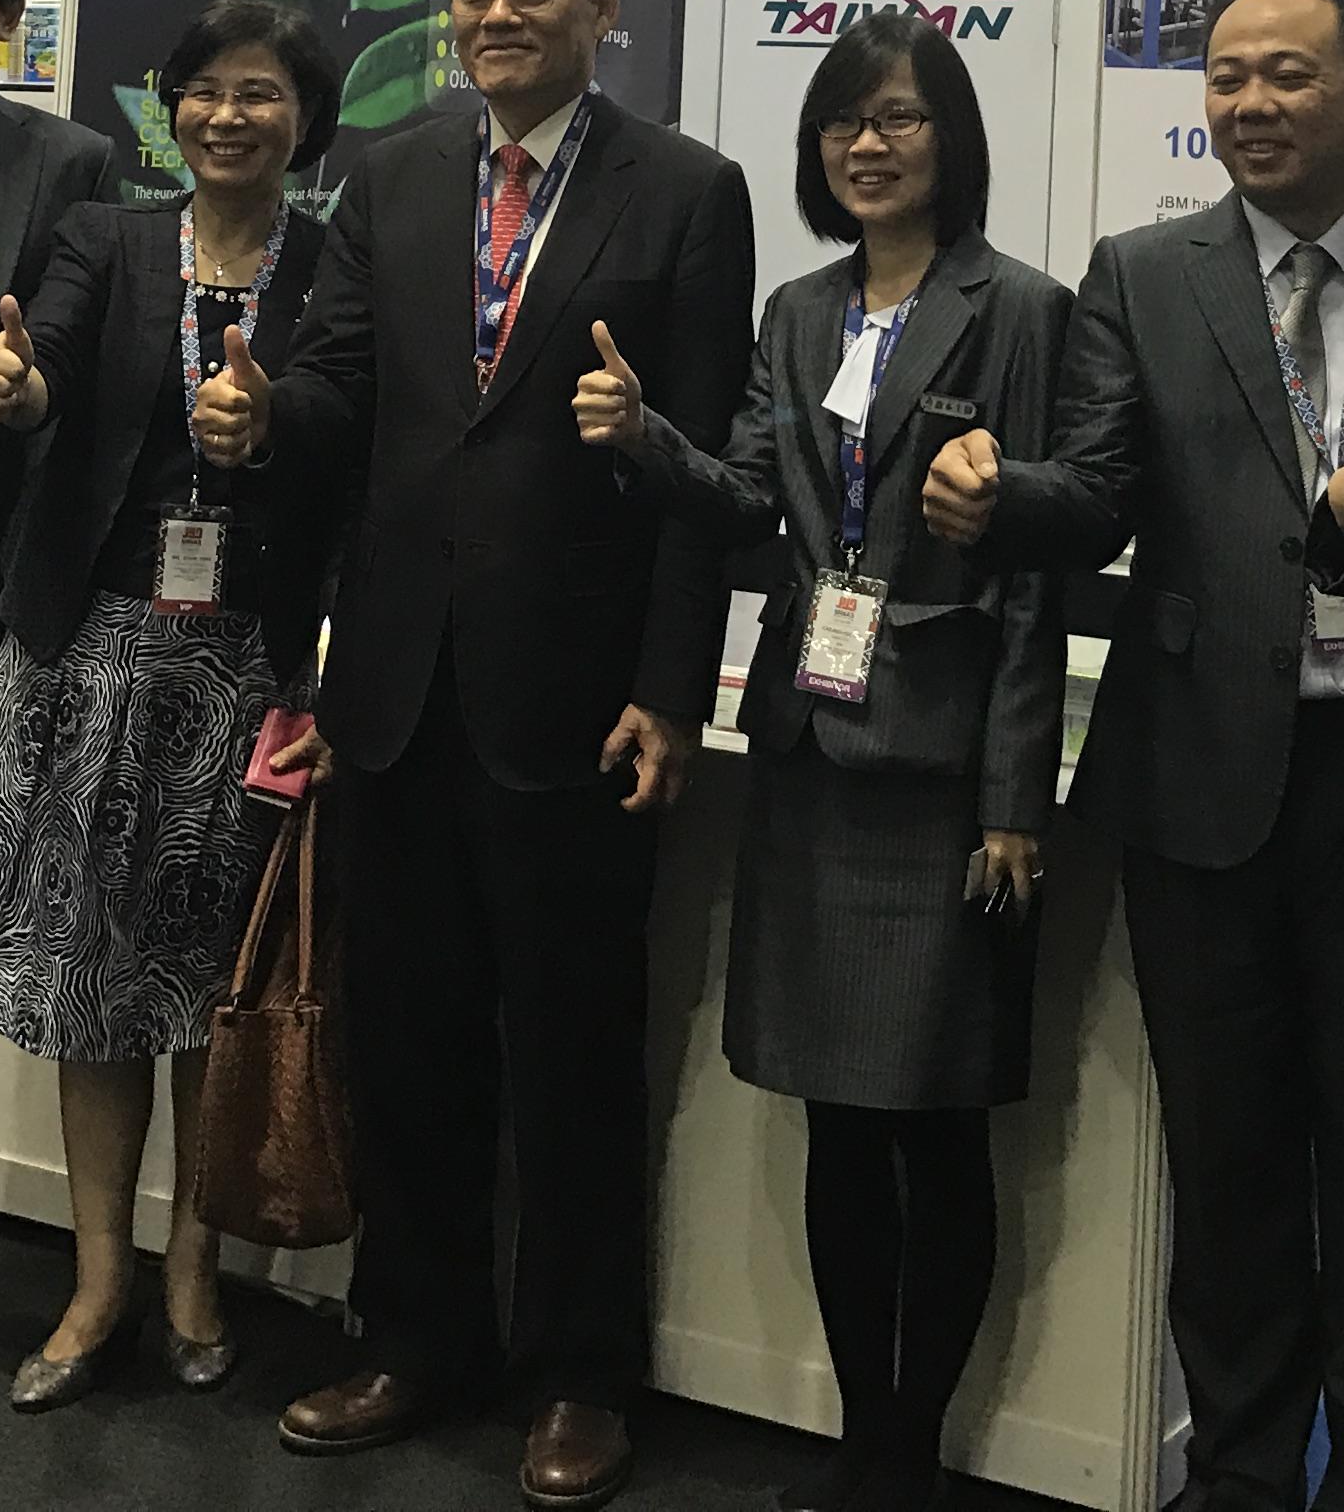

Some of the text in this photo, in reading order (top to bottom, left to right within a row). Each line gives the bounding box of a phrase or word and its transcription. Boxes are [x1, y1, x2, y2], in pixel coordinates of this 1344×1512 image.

[603, 29, 633, 49] rug.
[133, 185, 153, 199] The
[1156, 195, 1189, 210] JBM
